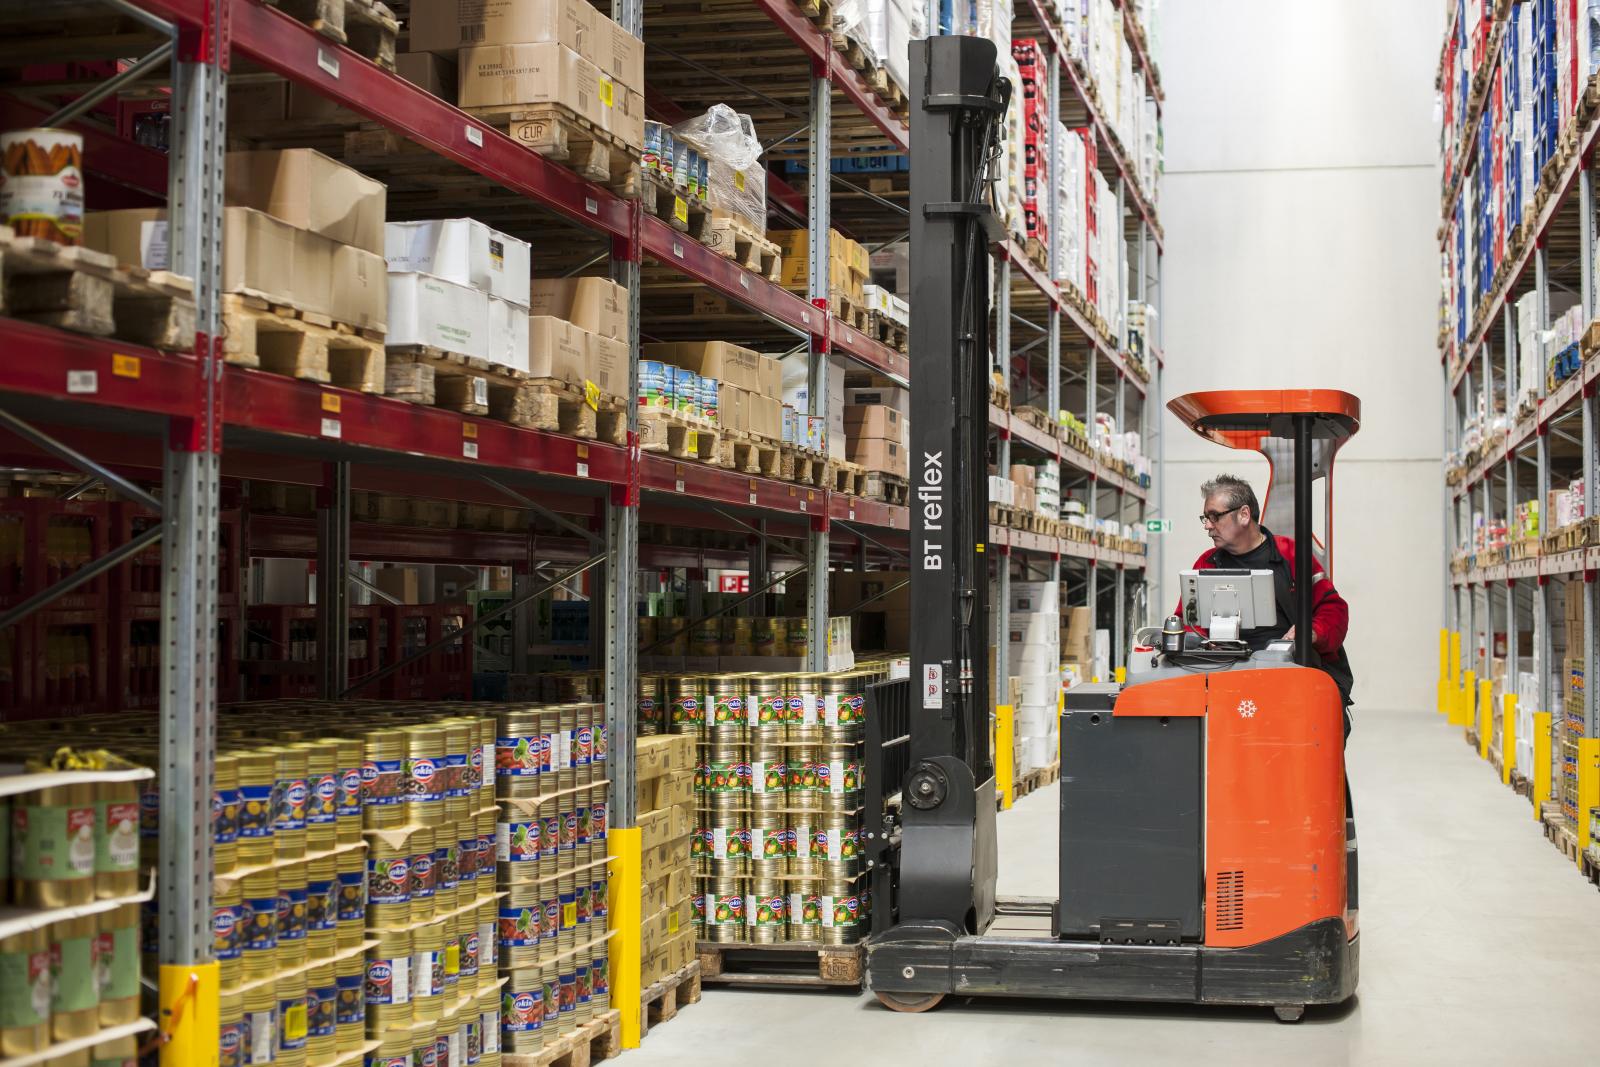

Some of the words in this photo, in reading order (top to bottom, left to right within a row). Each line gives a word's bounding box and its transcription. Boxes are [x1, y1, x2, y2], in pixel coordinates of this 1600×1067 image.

[524, 125, 543, 139] EUR
[918, 451, 942, 531] reflex
[923, 540, 942, 570] BT
[414, 766, 433, 776] okis
[389, 867, 406, 877] okis
[369, 967, 390, 977] okis
[517, 1000, 533, 1008] okis
